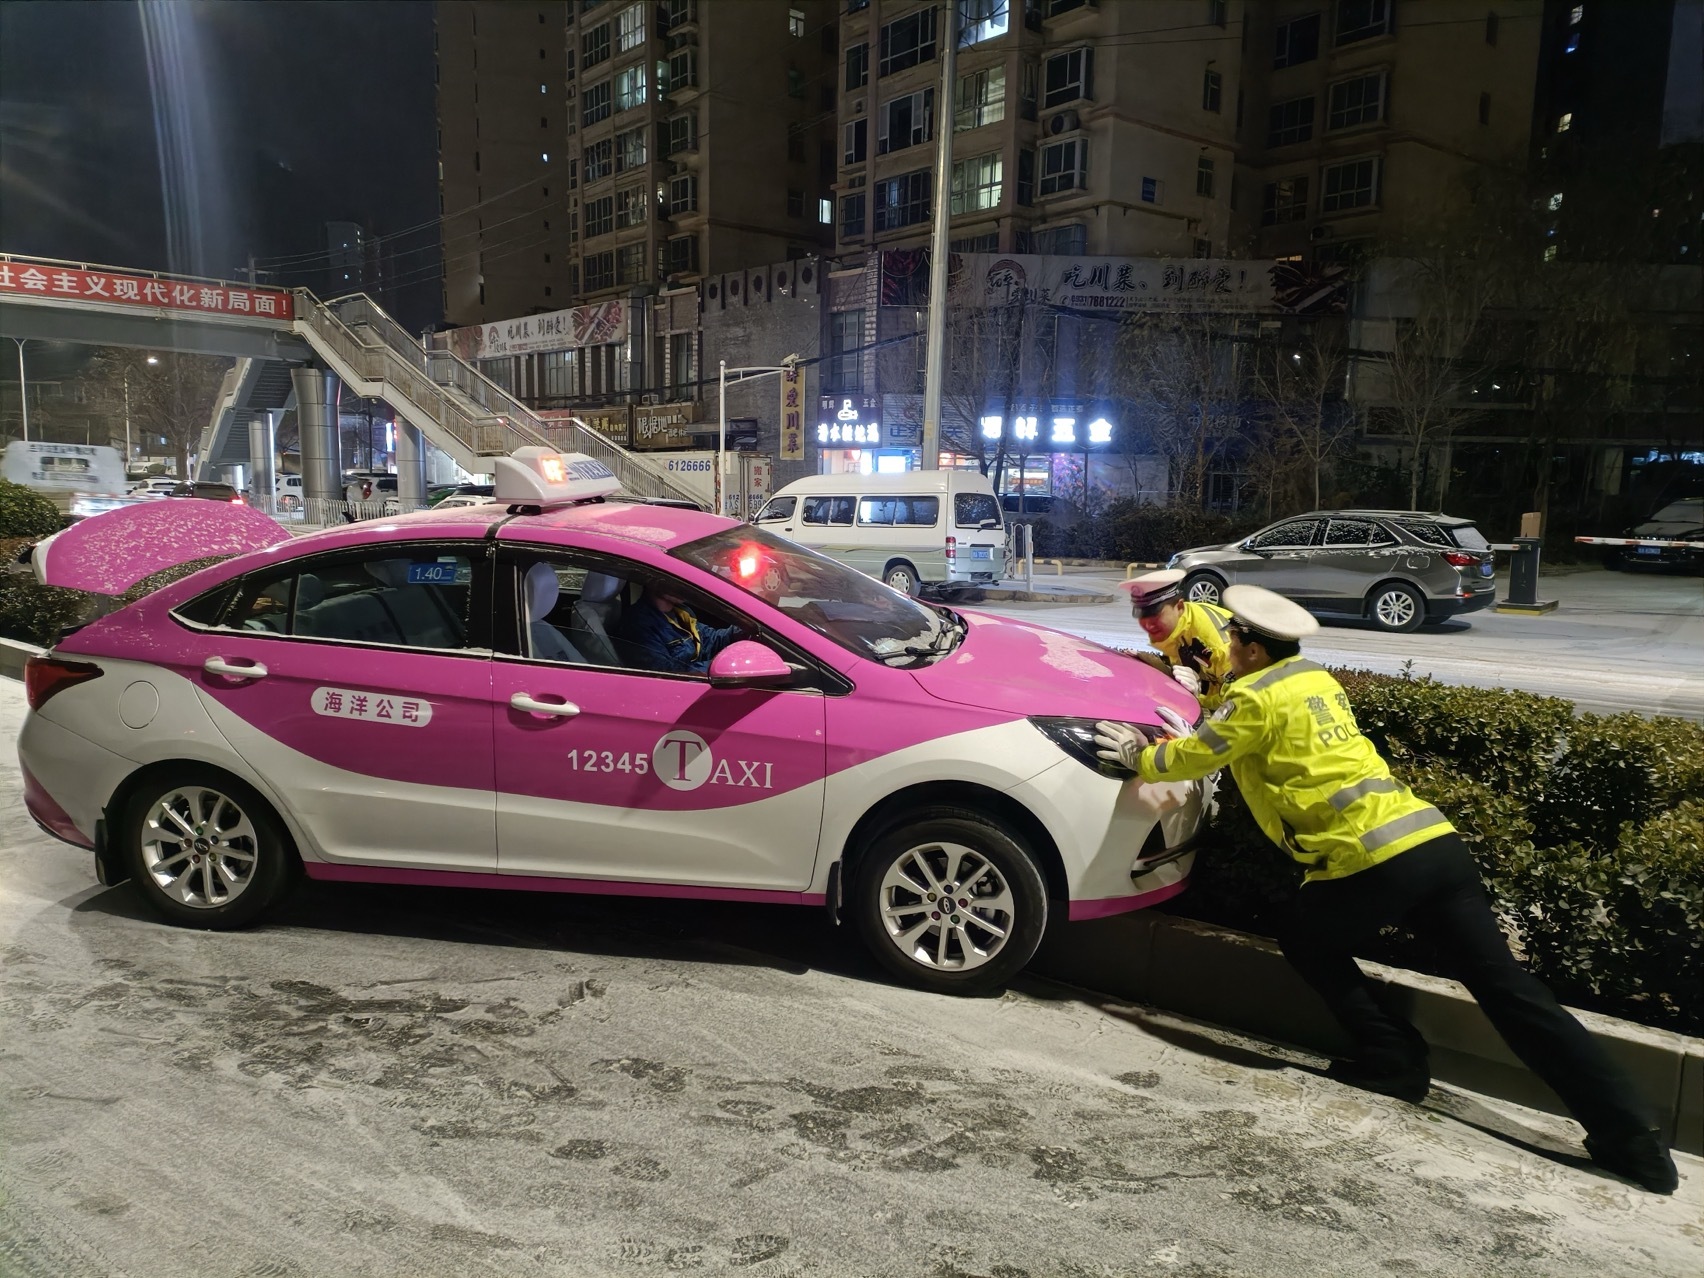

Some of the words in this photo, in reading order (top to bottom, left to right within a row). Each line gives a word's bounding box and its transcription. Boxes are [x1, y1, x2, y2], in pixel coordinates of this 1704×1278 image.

[668, 460, 711, 472] 6126666
[415, 567, 443, 580] 1.40
[324, 692, 420, 723] 海洋公司
[567, 750, 648, 775] 12345
[663, 739, 774, 789] TAXI
